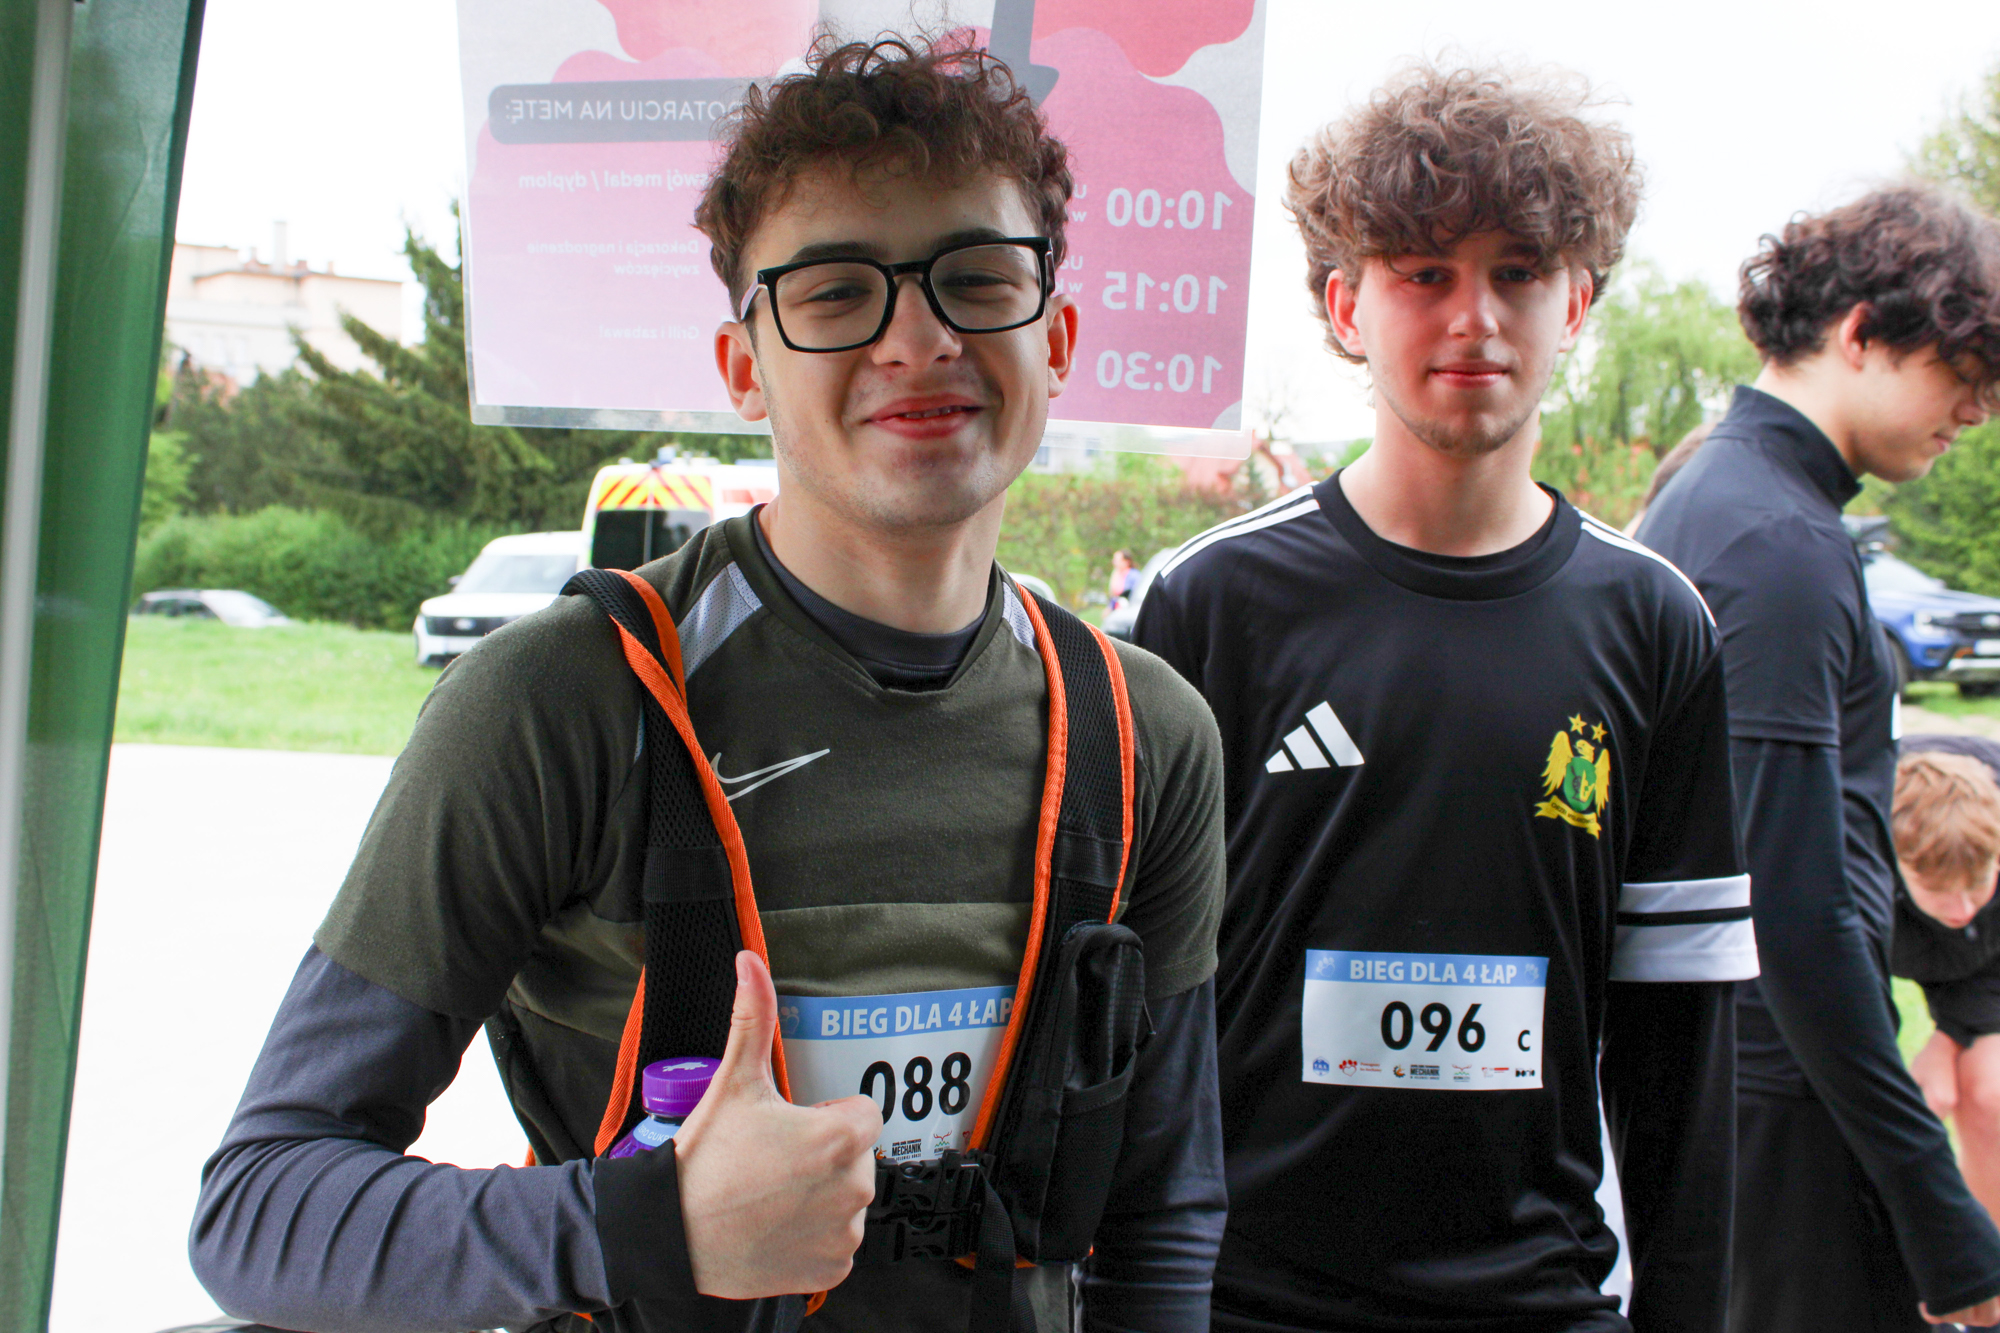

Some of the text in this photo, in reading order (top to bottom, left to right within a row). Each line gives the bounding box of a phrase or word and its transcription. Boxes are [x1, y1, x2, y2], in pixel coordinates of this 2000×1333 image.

[1351, 960, 1517, 985] BIEG DLA 4 ŁAP
[821, 998, 1015, 1036] BIEG DLA 4 ŁAP
[1381, 1000, 1486, 1052] 096
[859, 1052, 972, 1125] 088
[648, 1131, 674, 1142] CUKR
[892, 1142, 922, 1157] MECHANIK
